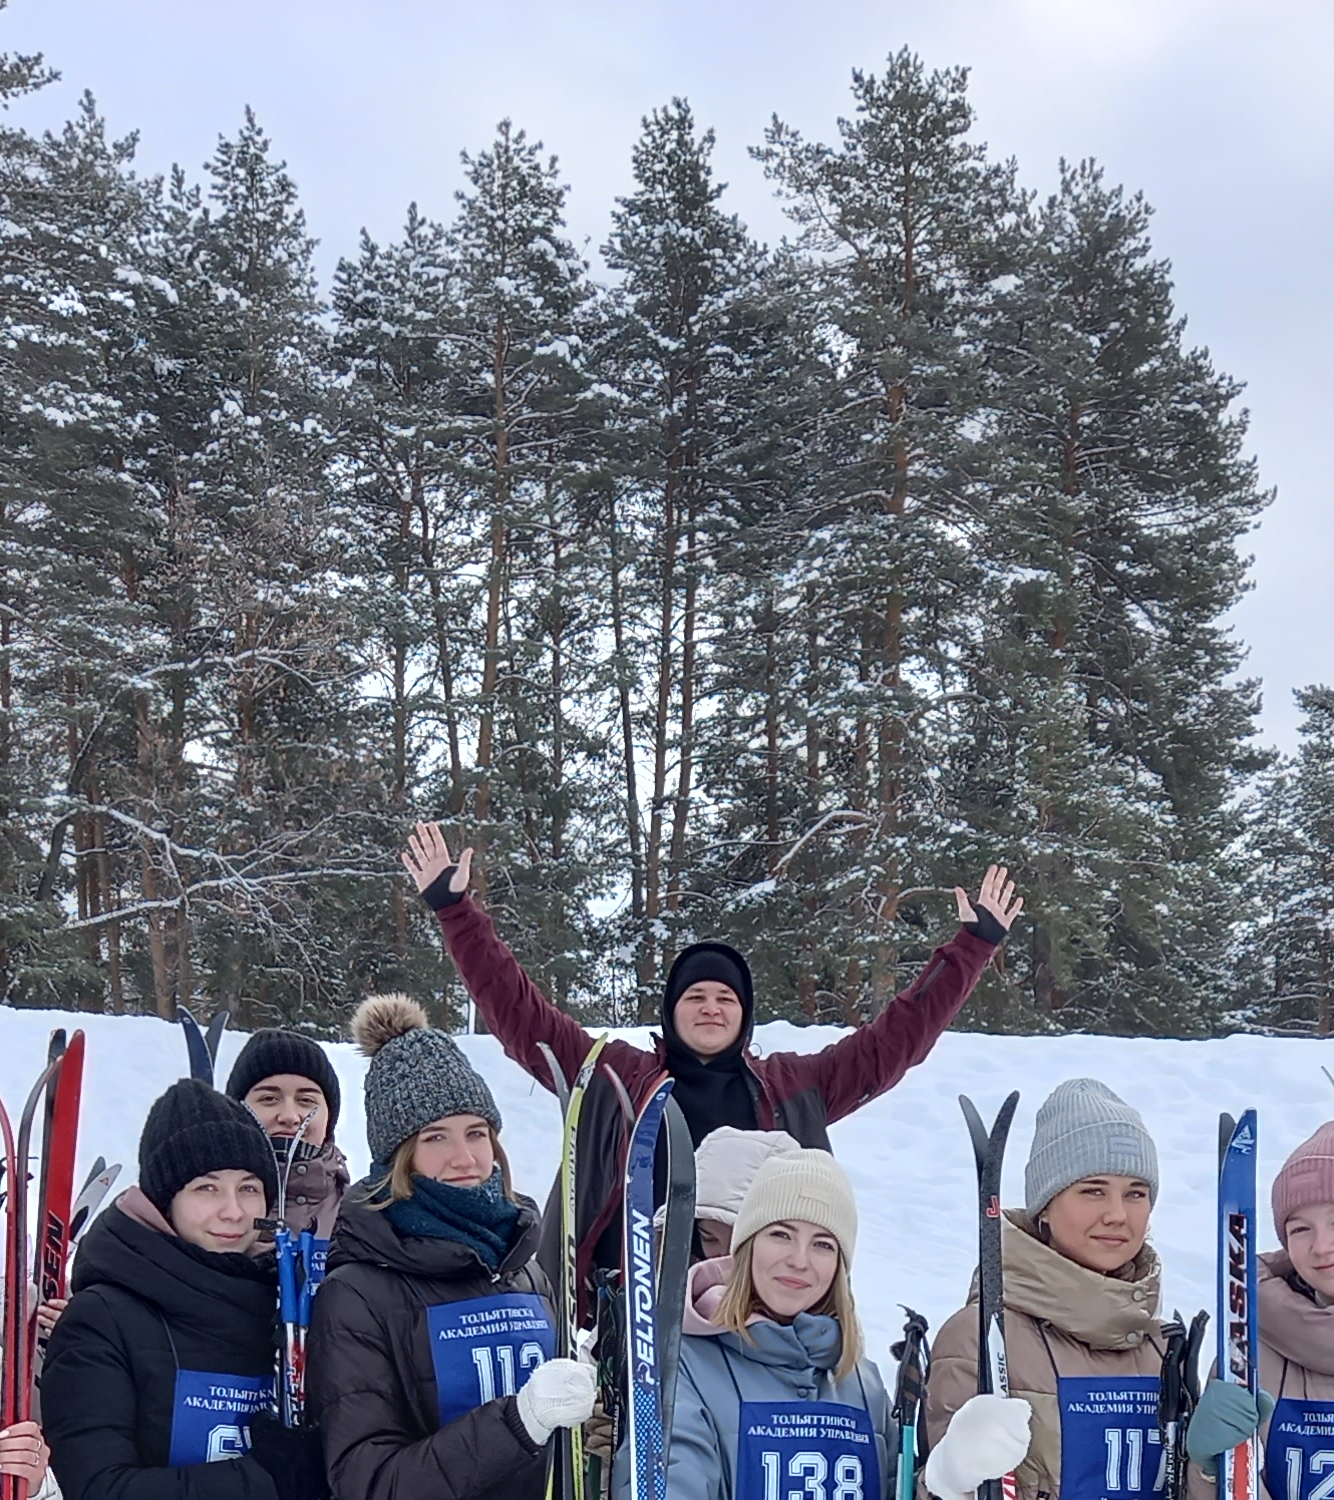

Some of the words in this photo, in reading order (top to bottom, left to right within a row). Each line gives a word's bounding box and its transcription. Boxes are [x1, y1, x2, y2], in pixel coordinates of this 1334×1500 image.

[42, 1210, 65, 1302] SEN
[631, 1210, 654, 1386] PELTONEN
[1229, 1213, 1248, 1388] LASKA
[438, 1321, 507, 1340] АКАДЕМИЯ
[998, 1351, 1009, 1398] ASSIC
[747, 1426, 817, 1438] АКАДЕМИЯ
[1067, 1403, 1133, 1414] АКАДЕМИЯ
